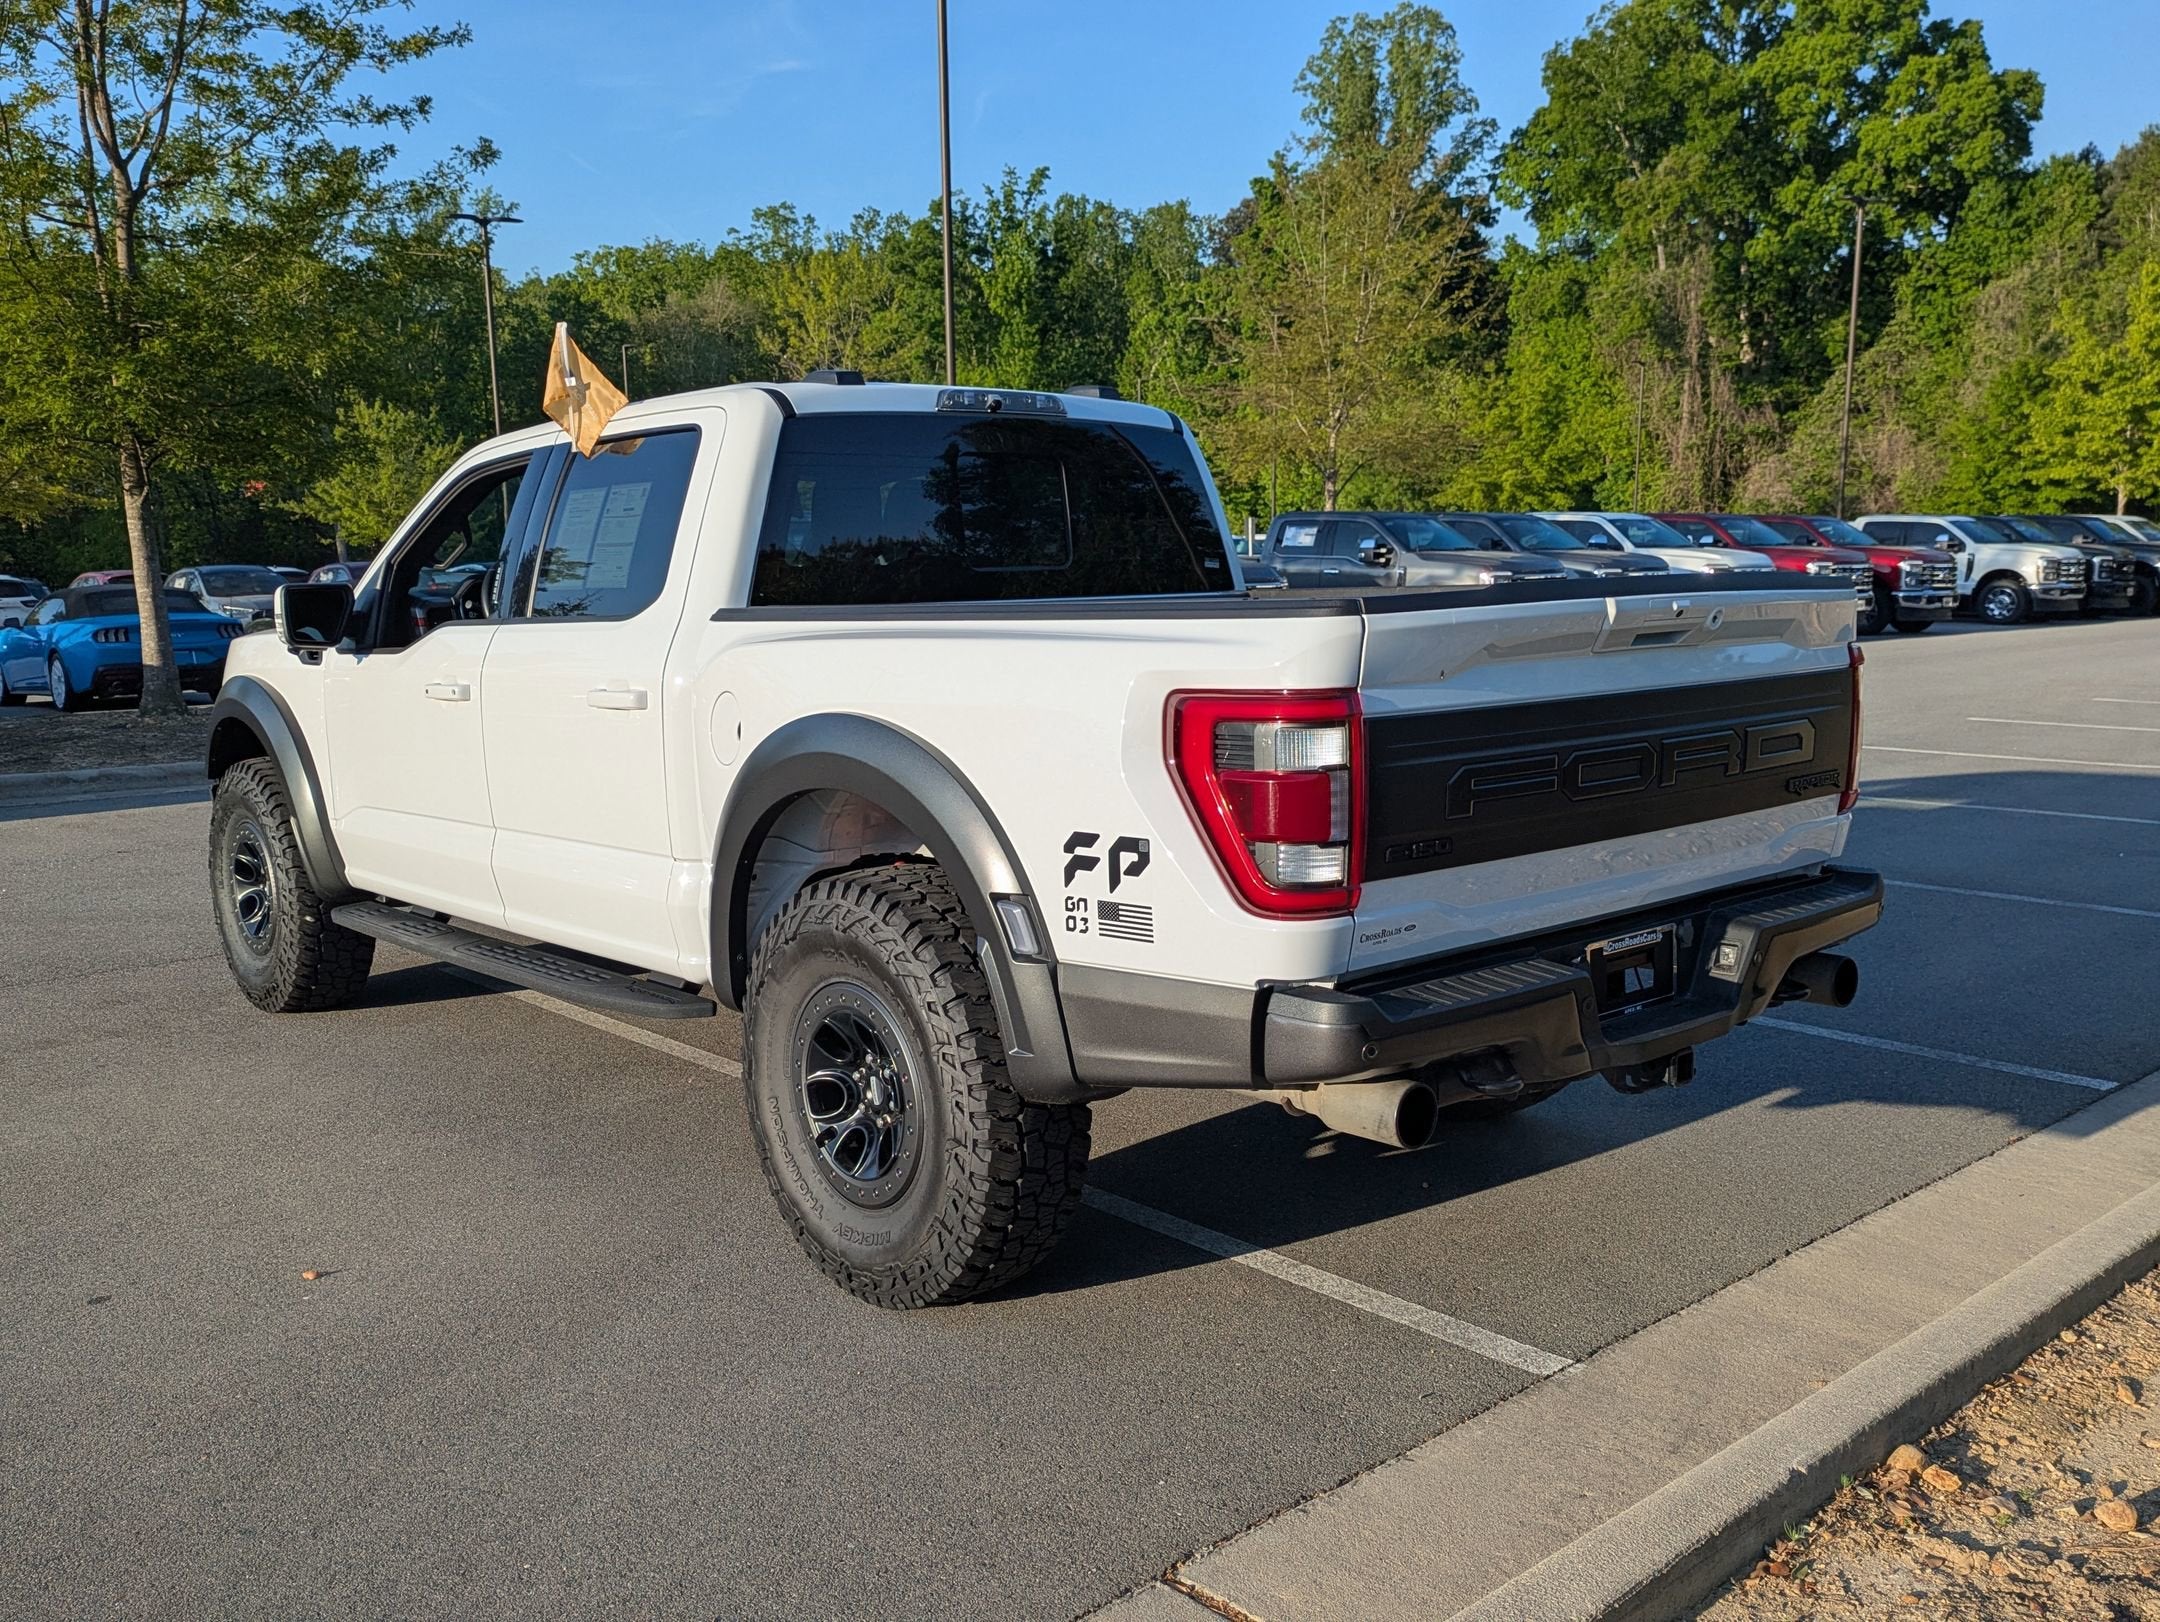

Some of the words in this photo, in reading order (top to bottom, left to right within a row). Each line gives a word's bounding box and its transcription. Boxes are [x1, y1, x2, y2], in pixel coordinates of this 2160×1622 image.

[1445, 718, 1817, 820] FORD
[1786, 769, 1841, 795] RAPTOR
[1063, 831, 1150, 894] FP
[1384, 838, 1453, 864] F-150
[768, 1096, 824, 1221] THOMPSON
[832, 1222, 891, 1246] MICKEY
